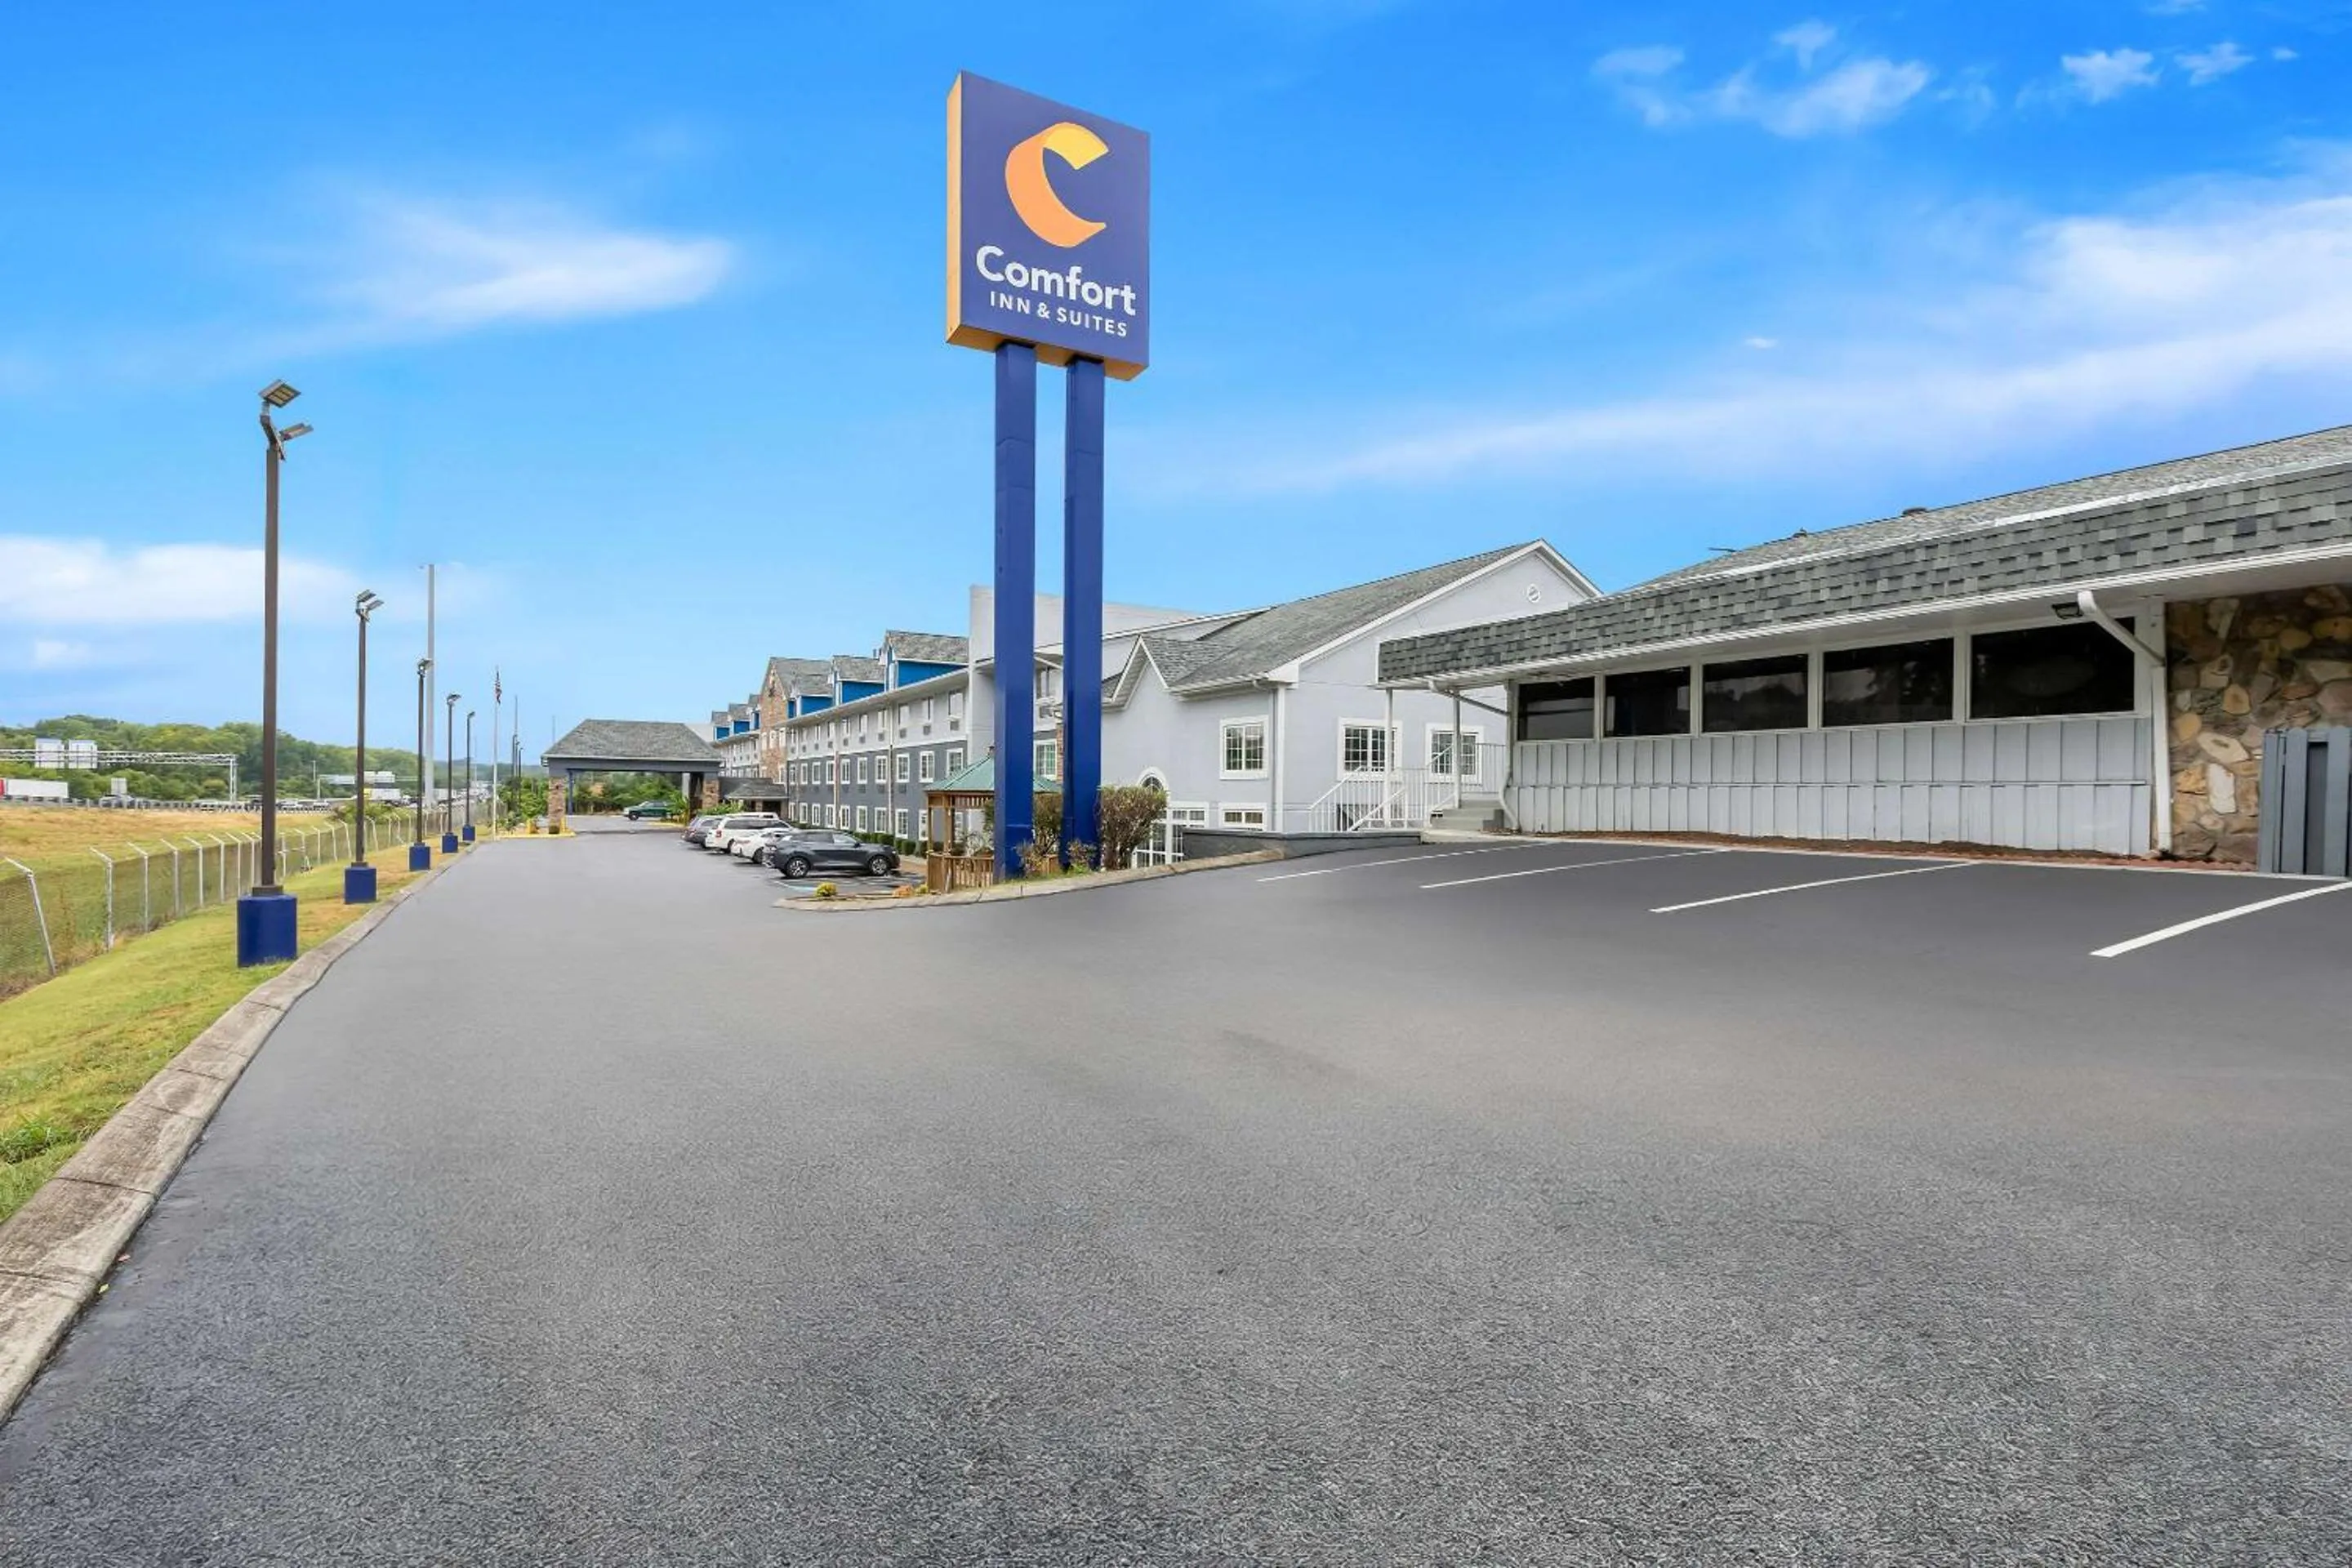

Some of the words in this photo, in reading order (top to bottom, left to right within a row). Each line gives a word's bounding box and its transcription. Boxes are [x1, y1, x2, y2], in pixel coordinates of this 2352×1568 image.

[976, 245, 1136, 316] Comfort
[990, 291, 1031, 314] INN
[1036, 302, 1050, 319] &
[1057, 307, 1127, 337] SUITES
